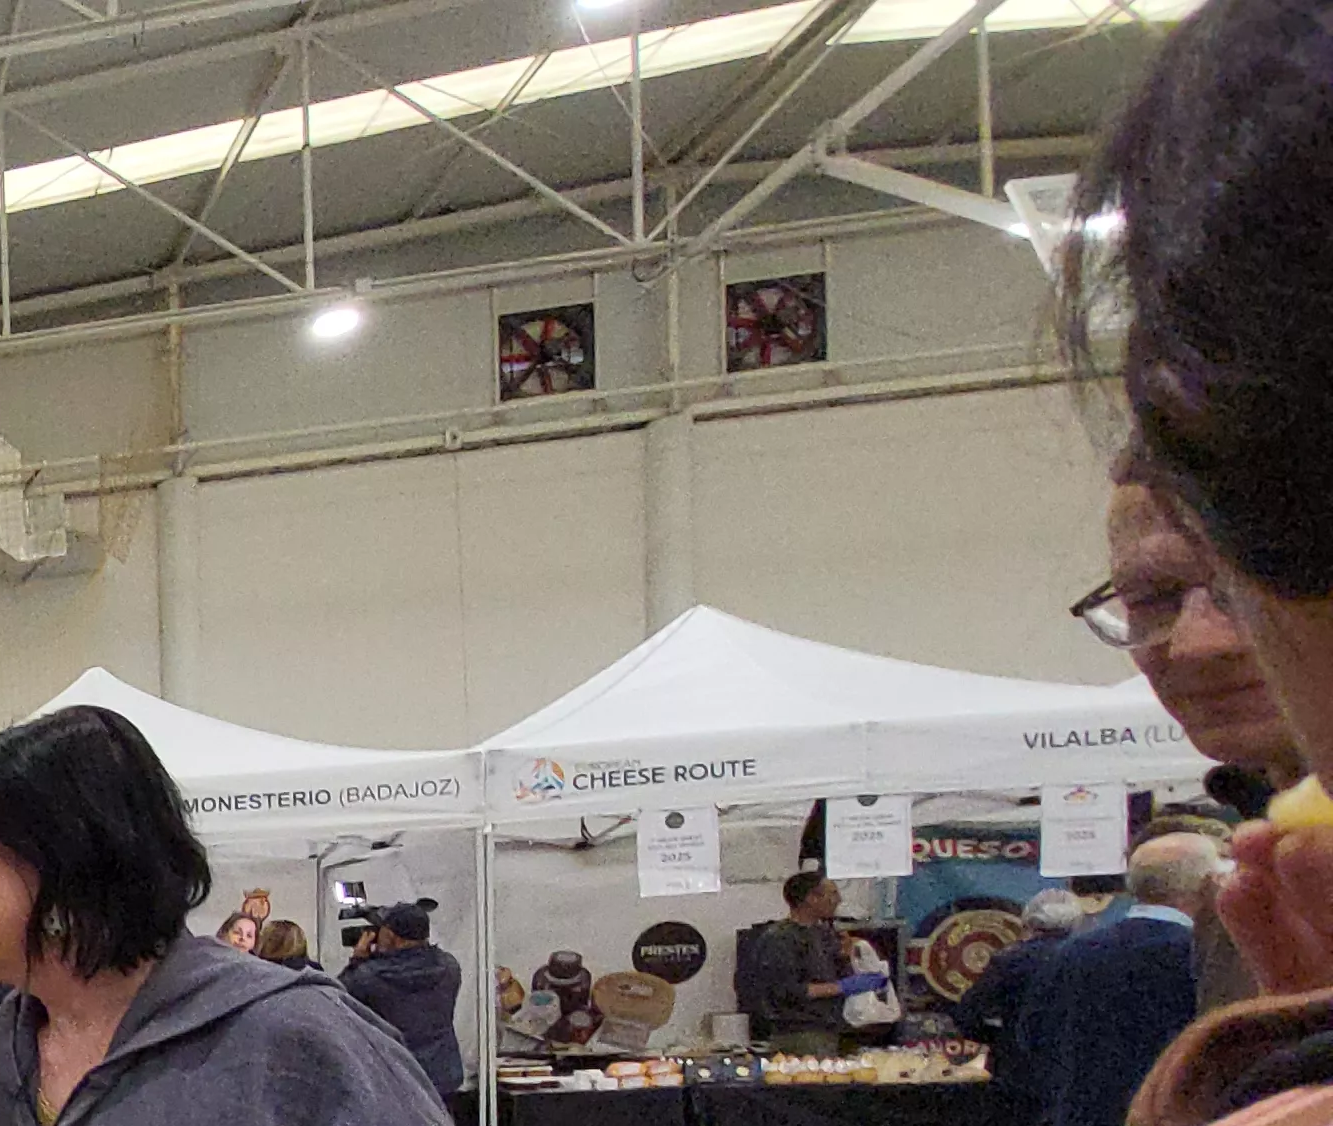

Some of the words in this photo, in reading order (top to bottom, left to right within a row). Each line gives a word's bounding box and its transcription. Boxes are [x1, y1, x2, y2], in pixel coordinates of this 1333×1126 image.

[1023, 727, 1137, 749] VILALBA
[1144, 724, 1184, 748] (LU
[572, 765, 666, 791] CHEESE
[674, 758, 757, 782] ROUTE
[183, 789, 332, 814] MONESTERIO
[339, 778, 460, 808] (BADAJOZ)
